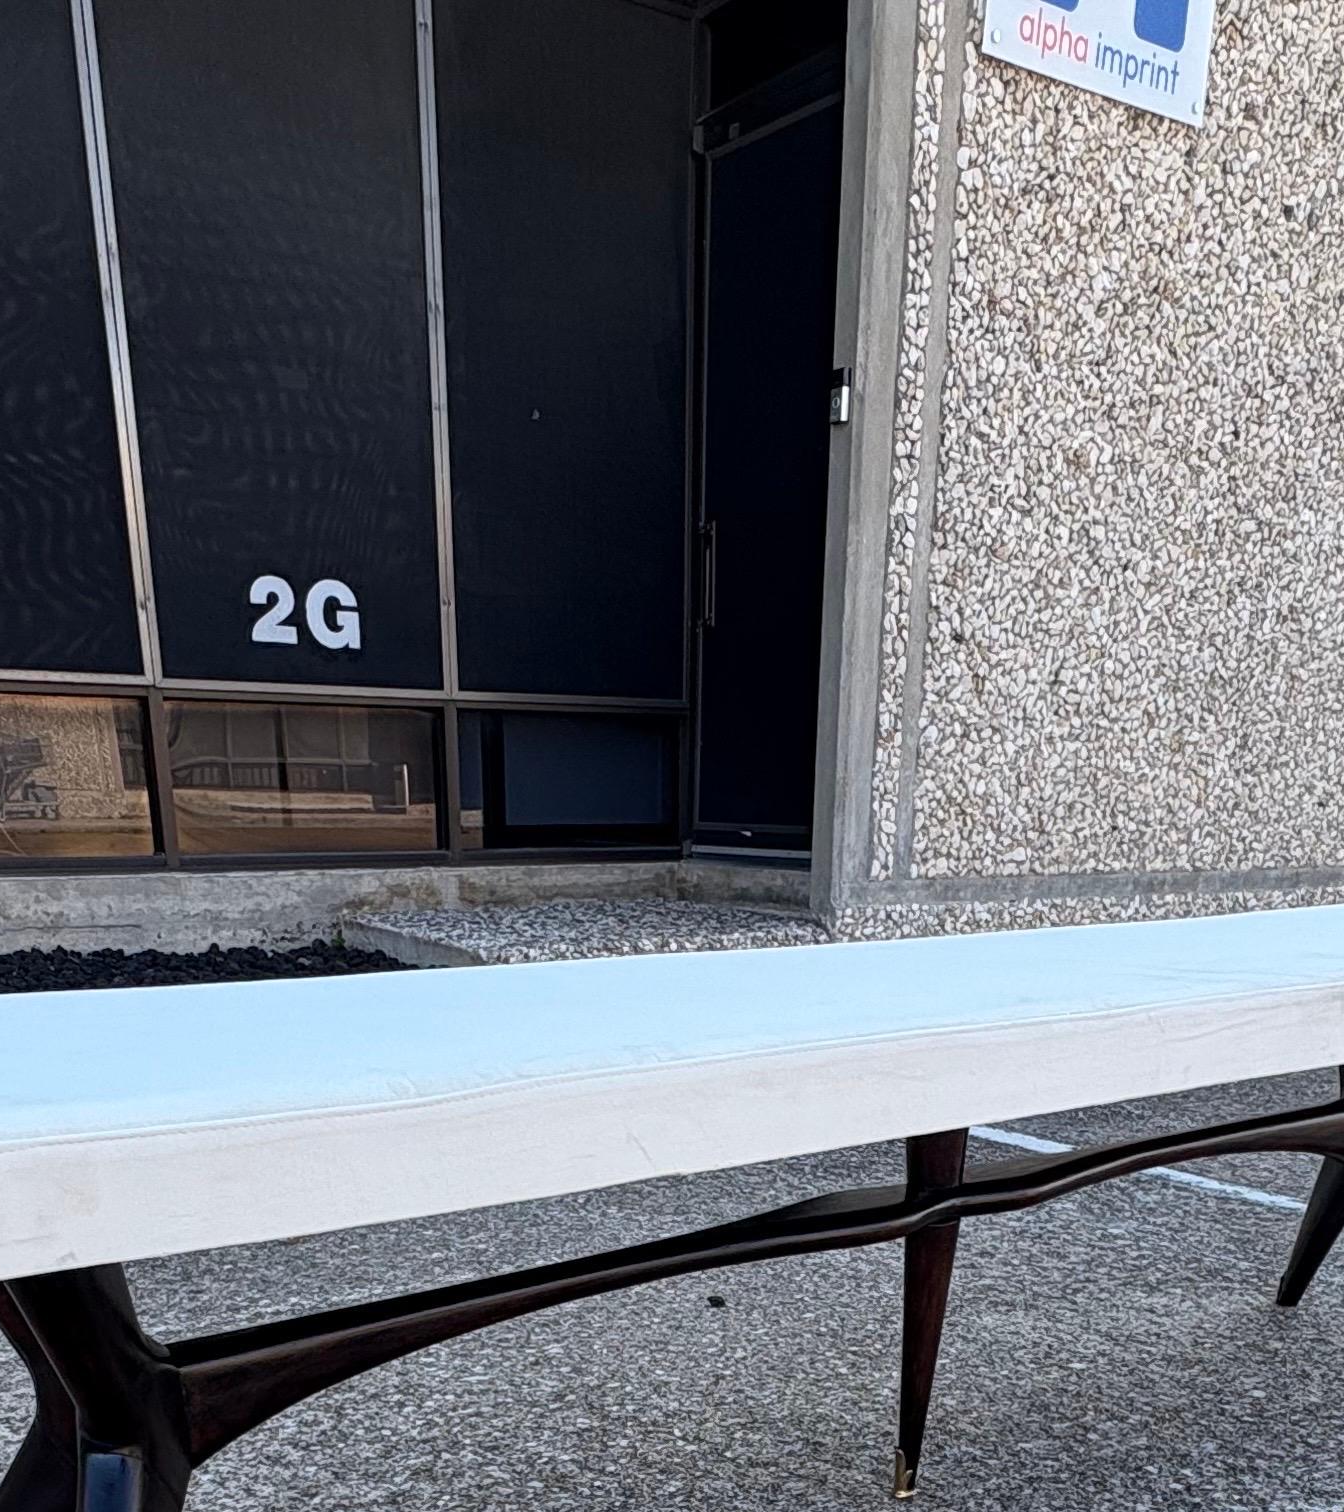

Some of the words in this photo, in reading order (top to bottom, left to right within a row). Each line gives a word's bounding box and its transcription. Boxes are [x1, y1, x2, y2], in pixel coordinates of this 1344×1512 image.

[1018, 7, 1089, 65] alpha
[1094, 31, 1180, 96] imprint
[249, 574, 361, 650] 2G
